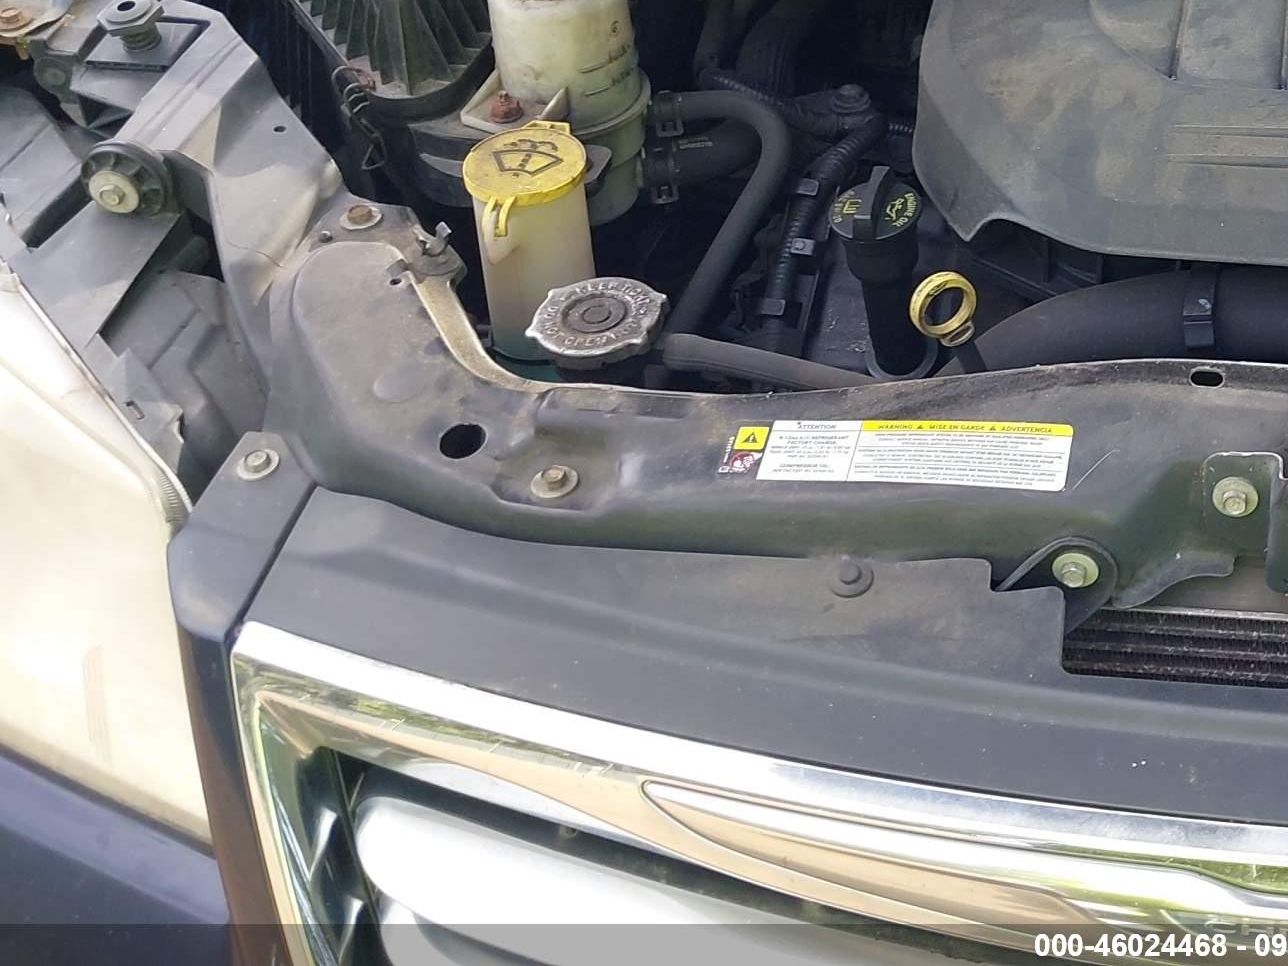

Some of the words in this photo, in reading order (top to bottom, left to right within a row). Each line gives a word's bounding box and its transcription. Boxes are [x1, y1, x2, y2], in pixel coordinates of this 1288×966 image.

[904, 192, 917, 217] ENGINE
[891, 216, 909, 227] OIL
[564, 336, 608, 347] OPEN
